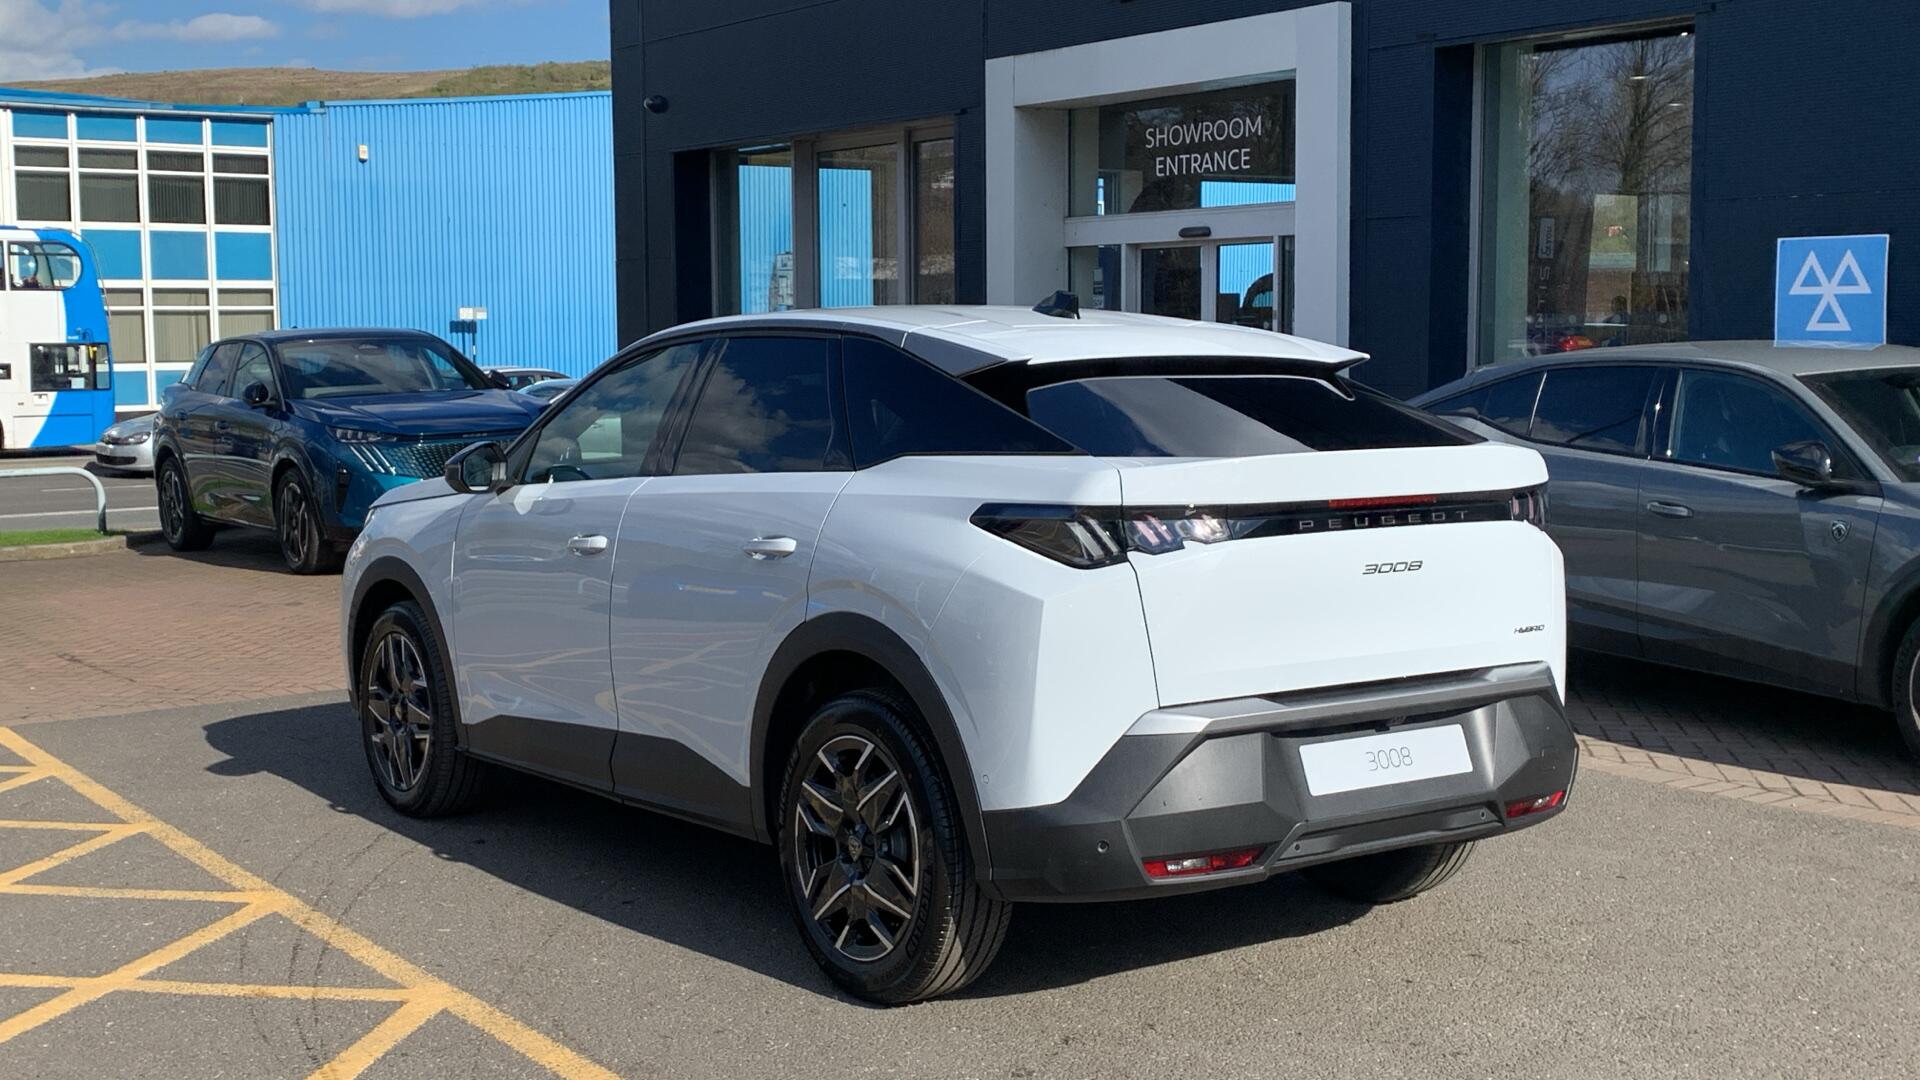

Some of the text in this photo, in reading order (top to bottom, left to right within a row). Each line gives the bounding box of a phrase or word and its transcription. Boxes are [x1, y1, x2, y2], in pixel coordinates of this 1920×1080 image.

[1145, 115, 1262, 149] SHOWROOM
[1155, 148, 1251, 177] ENTRANCE
[1299, 510, 1468, 530] PEUGEOT
[1362, 560, 1423, 575] 3008
[1365, 746, 1413, 771] 3008
